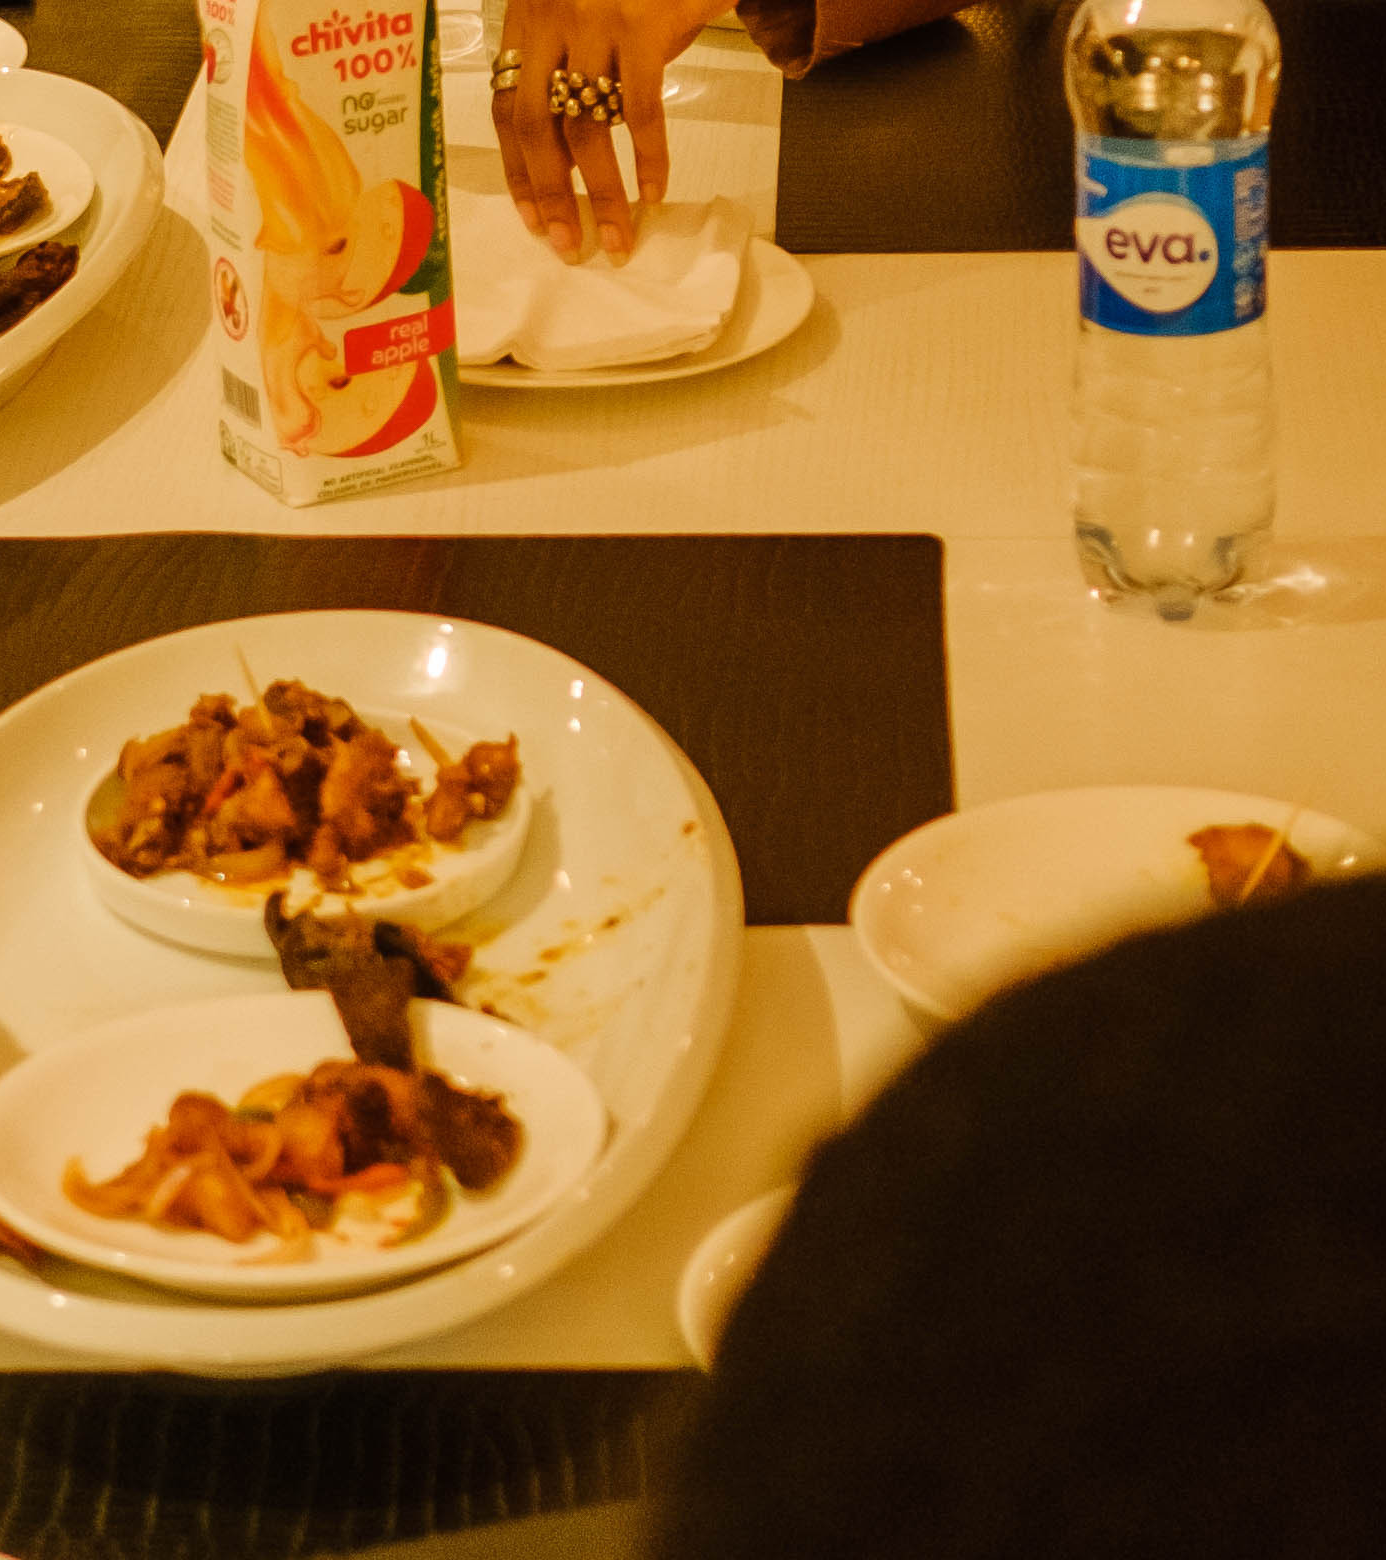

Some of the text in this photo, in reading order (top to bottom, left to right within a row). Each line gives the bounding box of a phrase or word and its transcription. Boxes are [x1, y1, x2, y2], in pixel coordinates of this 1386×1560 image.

[290, 9, 414, 58] chivita
[333, 42, 417, 83] 100%
[342, 91, 376, 114] no
[343, 106, 409, 136] sugar
[1105, 227, 1210, 265] eva.
[389, 313, 429, 341] real
[371, 335, 430, 367] apple
